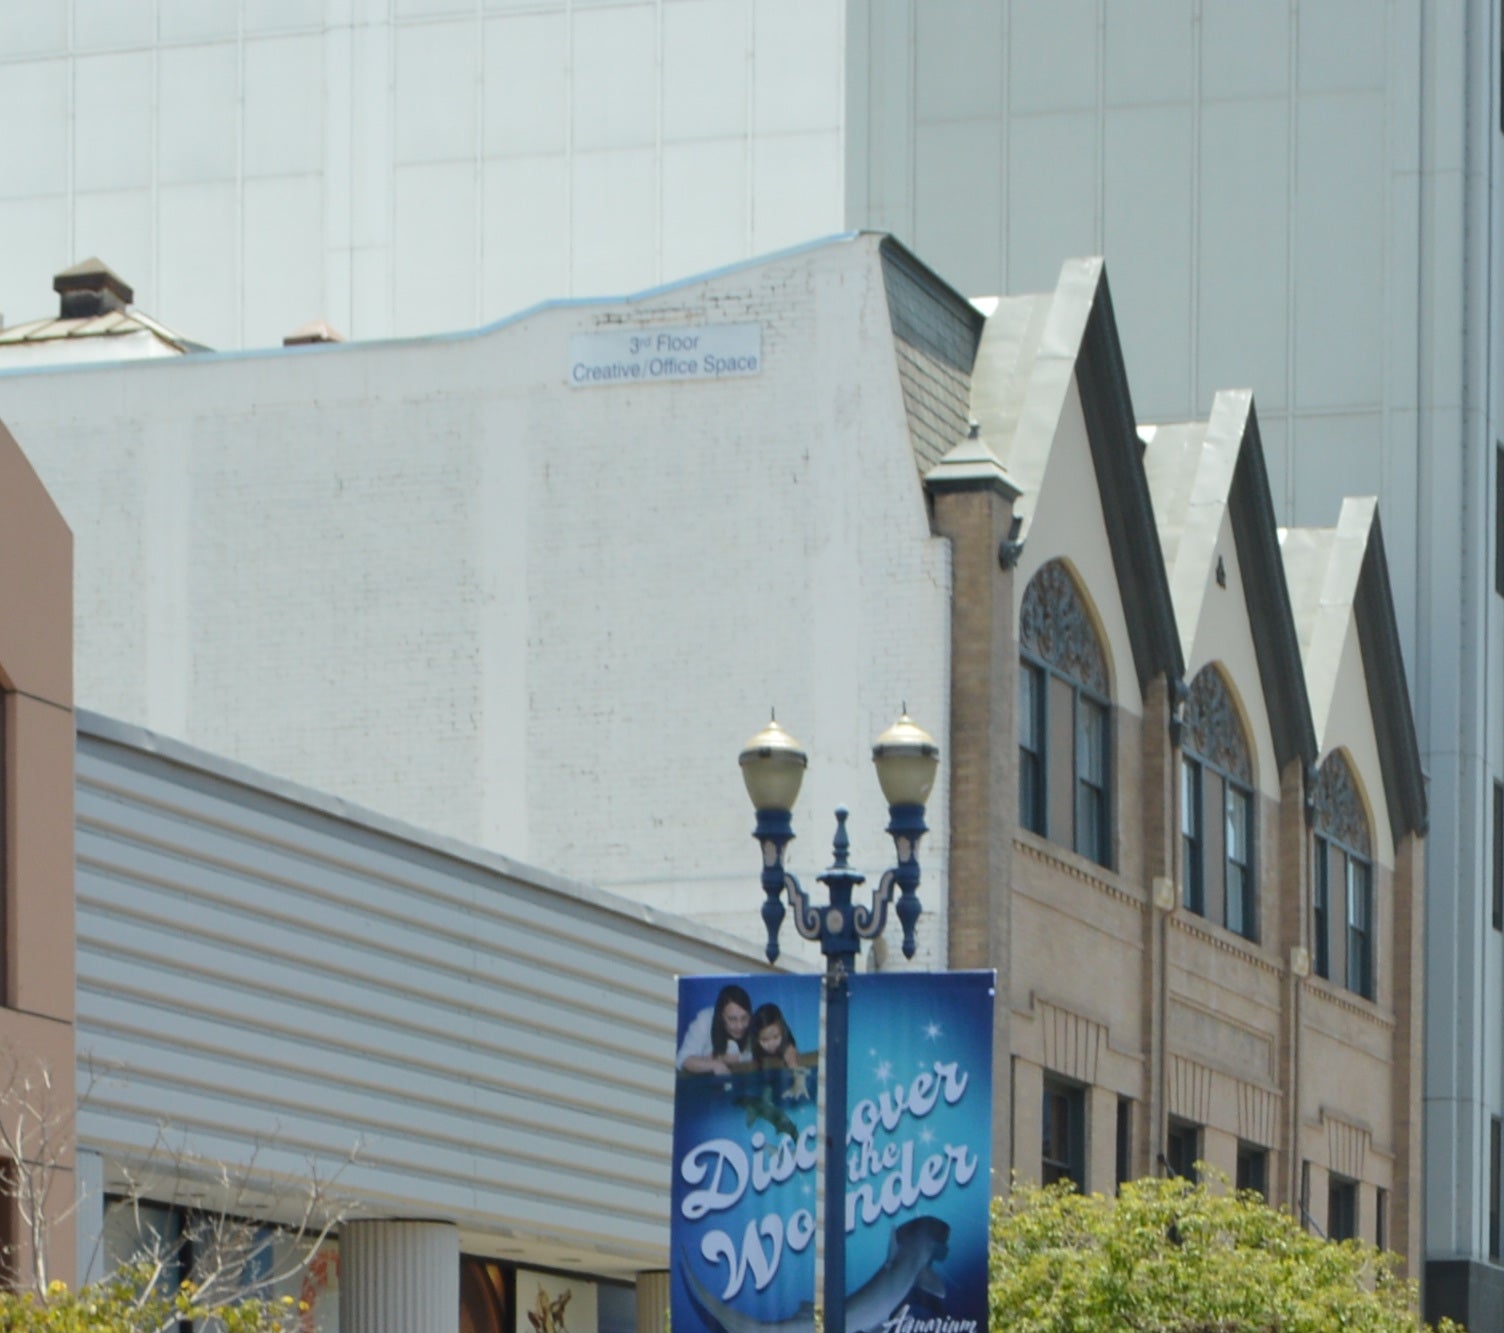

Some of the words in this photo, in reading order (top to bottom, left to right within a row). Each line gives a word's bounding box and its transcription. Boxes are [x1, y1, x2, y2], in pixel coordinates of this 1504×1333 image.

[656, 333, 700, 353] Floor
[703, 354, 758, 375] Space
[848, 1137, 900, 1183] the
